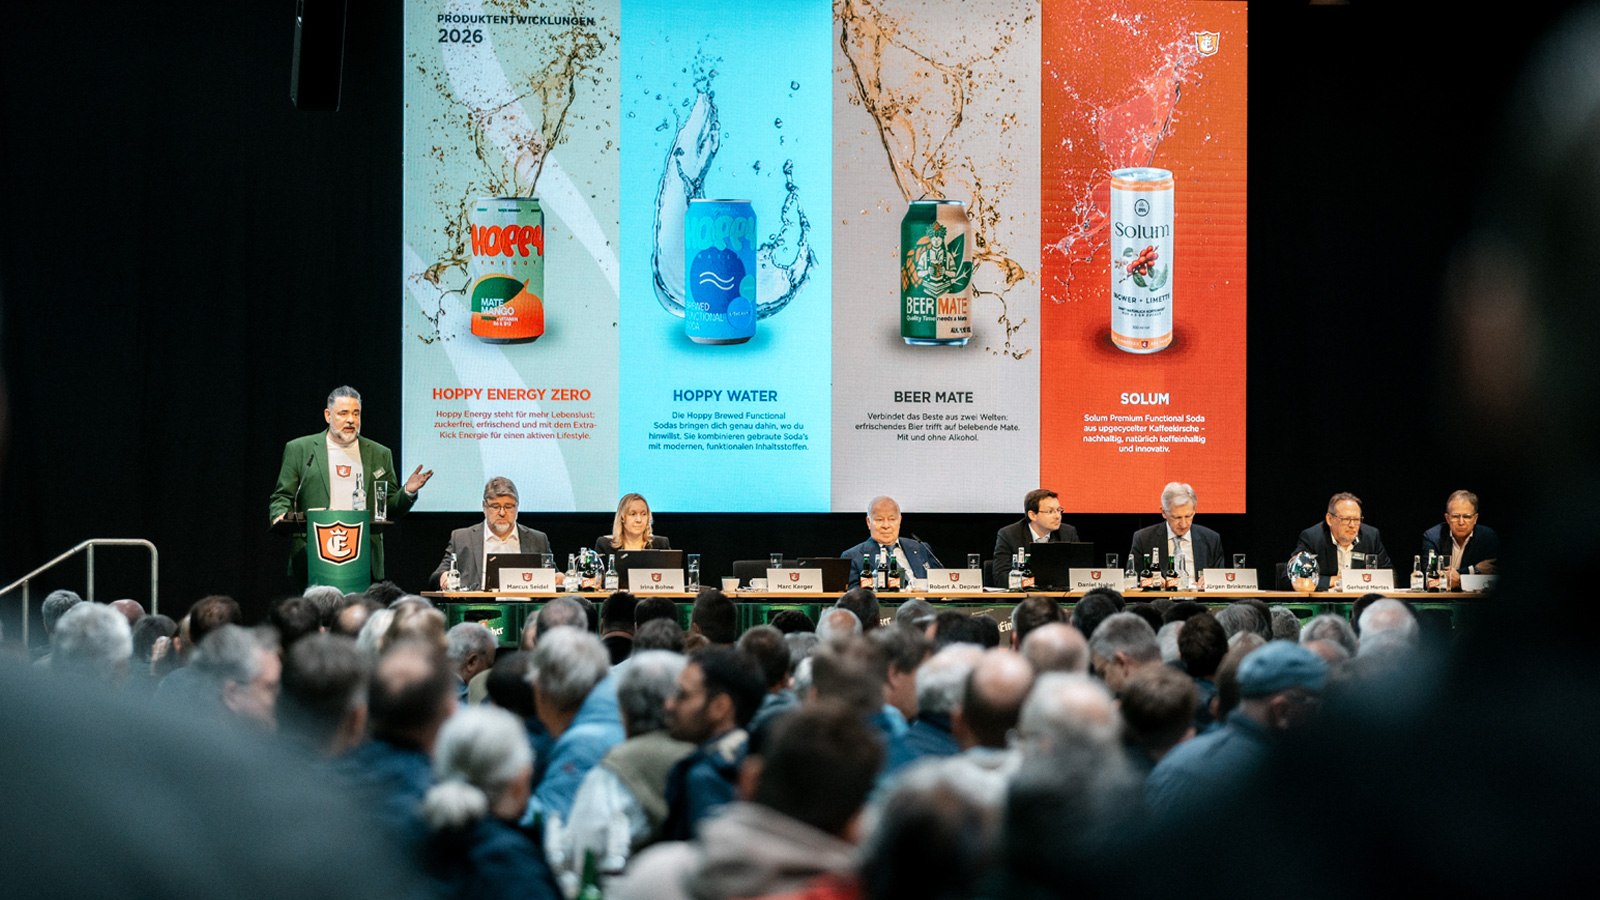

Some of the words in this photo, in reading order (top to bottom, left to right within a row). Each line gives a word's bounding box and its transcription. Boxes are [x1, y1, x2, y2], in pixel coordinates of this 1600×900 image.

[437, 14, 595, 26] PRODUKTENTWICKLUNGEN
[438, 29, 483, 43] 2026
[1115, 221, 1169, 239] Solum
[471, 223, 544, 257] HOPPY
[481, 297, 504, 306] MATE
[906, 296, 935, 315] BEER
[937, 297, 968, 315] MATE
[481, 306, 515, 316] MANGO
[432, 388, 483, 400] HOPPY
[487, 388, 546, 401] ENERGY
[551, 389, 591, 401] ZERO
[673, 389, 722, 401] HOPPY
[727, 390, 778, 402] WATER
[894, 391, 931, 403] BEER
[935, 391, 974, 404] MATE
[1120, 392, 1170, 405] SOLUM
[436, 410, 463, 419] Hoppy
[464, 410, 492, 419] Energy
[494, 410, 514, 418] steht
[515, 410, 527, 418] für
[528, 410, 549, 418] mehr
[551, 410, 596, 419] Lebenslust:
[672, 411, 685, 419] Die
[686, 411, 713, 420] Hoppy
[746, 412, 786, 420] Functional
[867, 412, 905, 420] Verbindet
[906, 412, 921, 420] das
[922, 413, 944, 421] Beste
[960, 413, 978, 421] zwei
[979, 413, 1008, 421] Welten:
[1084, 414, 1108, 422] Solum
[1110, 414, 1143, 422] Premium
[1145, 414, 1184, 422] Functional
[434, 421, 474, 429] zuckerfrei,
[653, 421, 678, 429] Sodas
[679, 421, 709, 430] bringen
[710, 421, 728, 429] dich
[755, 422, 779, 430] dahin,
[793, 422, 804, 430] du
[958, 423, 998, 431] belebende
[1098, 424, 1147, 433] upgecycelter
[439, 431, 457, 439] Kick
[458, 431, 489, 440] Energie
[526, 431, 555, 439] aktiven
[556, 432, 592, 440] Lifestyle.
[648, 432, 682, 440] hinwillst.
[684, 432, 696, 440] Sie
[698, 432, 745, 440] kombinieren
[746, 433, 782, 441] gebraute
[897, 433, 909, 441] Mit
[910, 433, 925, 441] und
[927, 433, 947, 441] ohne
[948, 433, 979, 441] Alkohol.
[1083, 435, 1124, 443] nachhaltig,
[1159, 435, 1206, 444] koffeinhaltig
[648, 442, 661, 450] mit
[663, 443, 705, 451] modernen,
[755, 443, 809, 451] Inhaltsstoffen.
